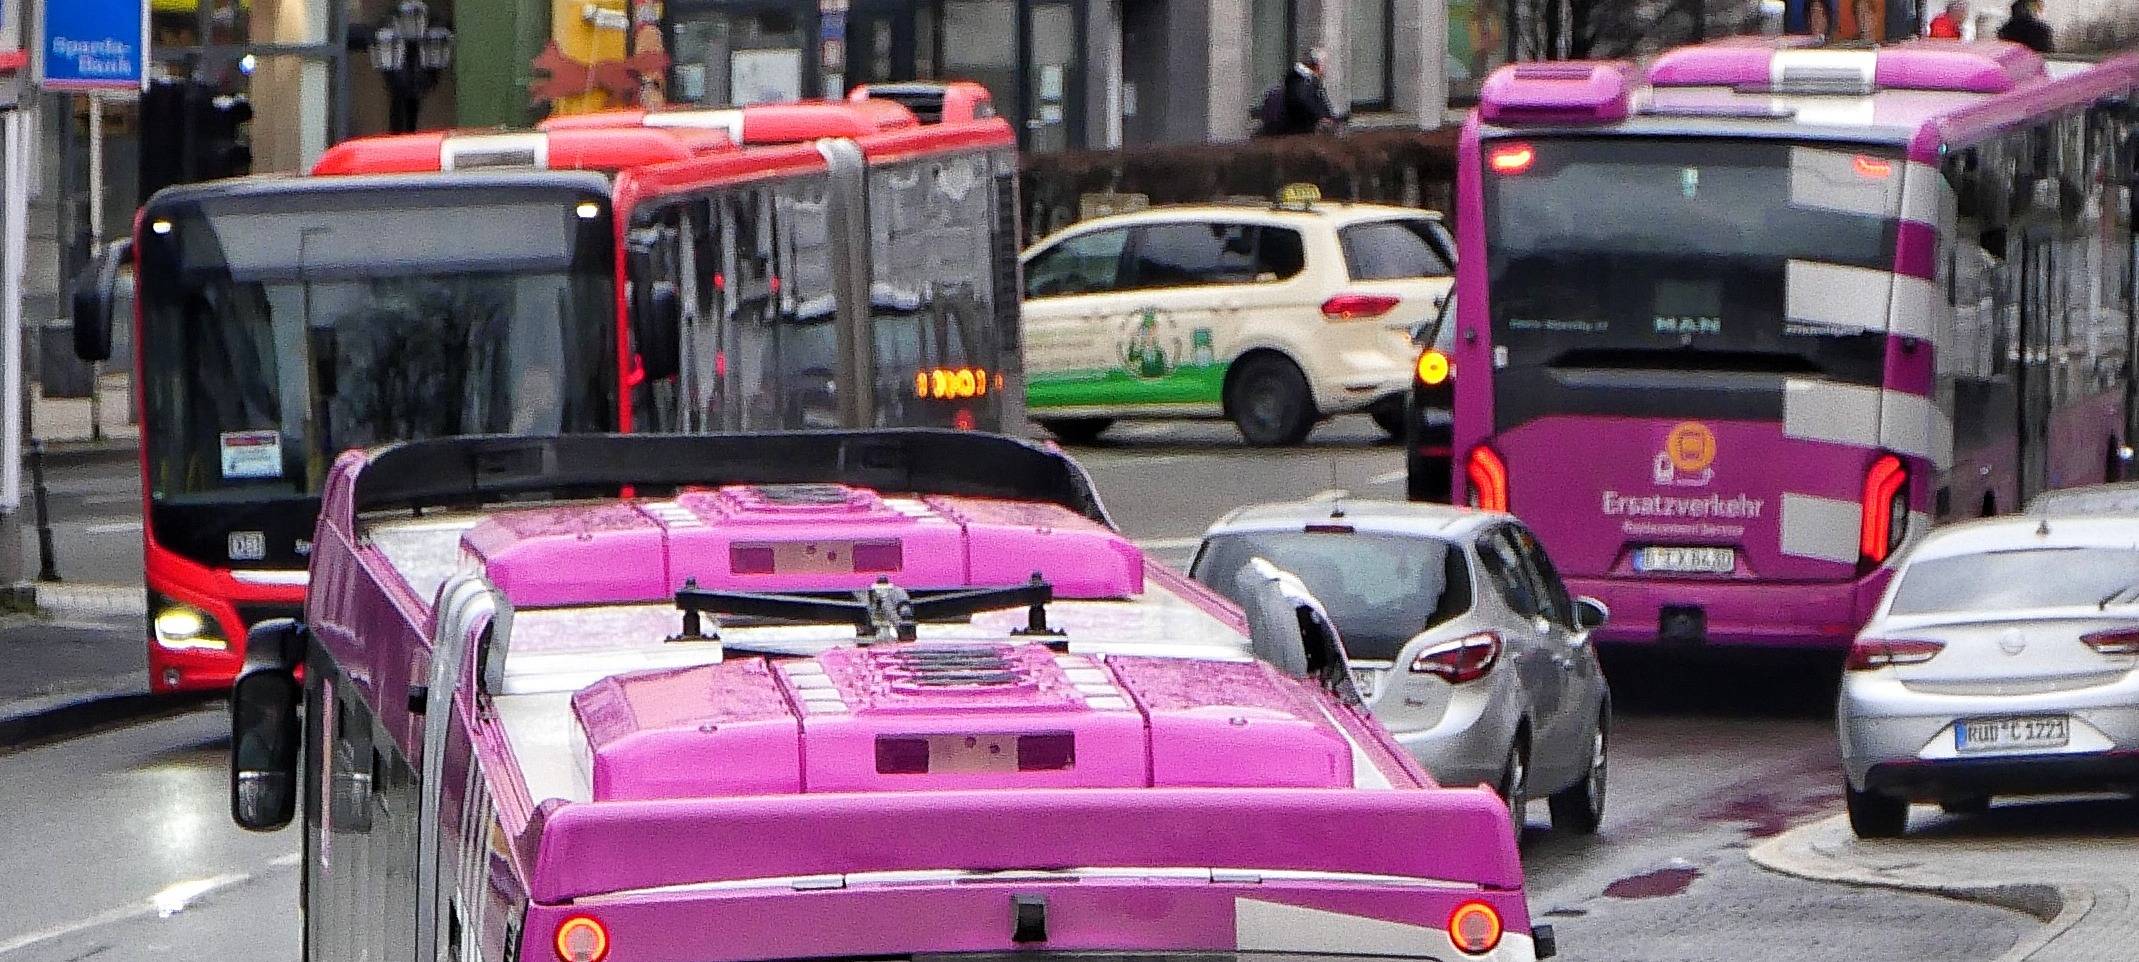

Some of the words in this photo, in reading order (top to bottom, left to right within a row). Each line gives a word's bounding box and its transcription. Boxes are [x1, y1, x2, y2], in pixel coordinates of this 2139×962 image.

[79, 54, 131, 73] Bank
[1656, 317, 1720, 332] MAN
[1603, 491, 1764, 519] Ersatzverkehr
[231, 534, 263, 557] DB
